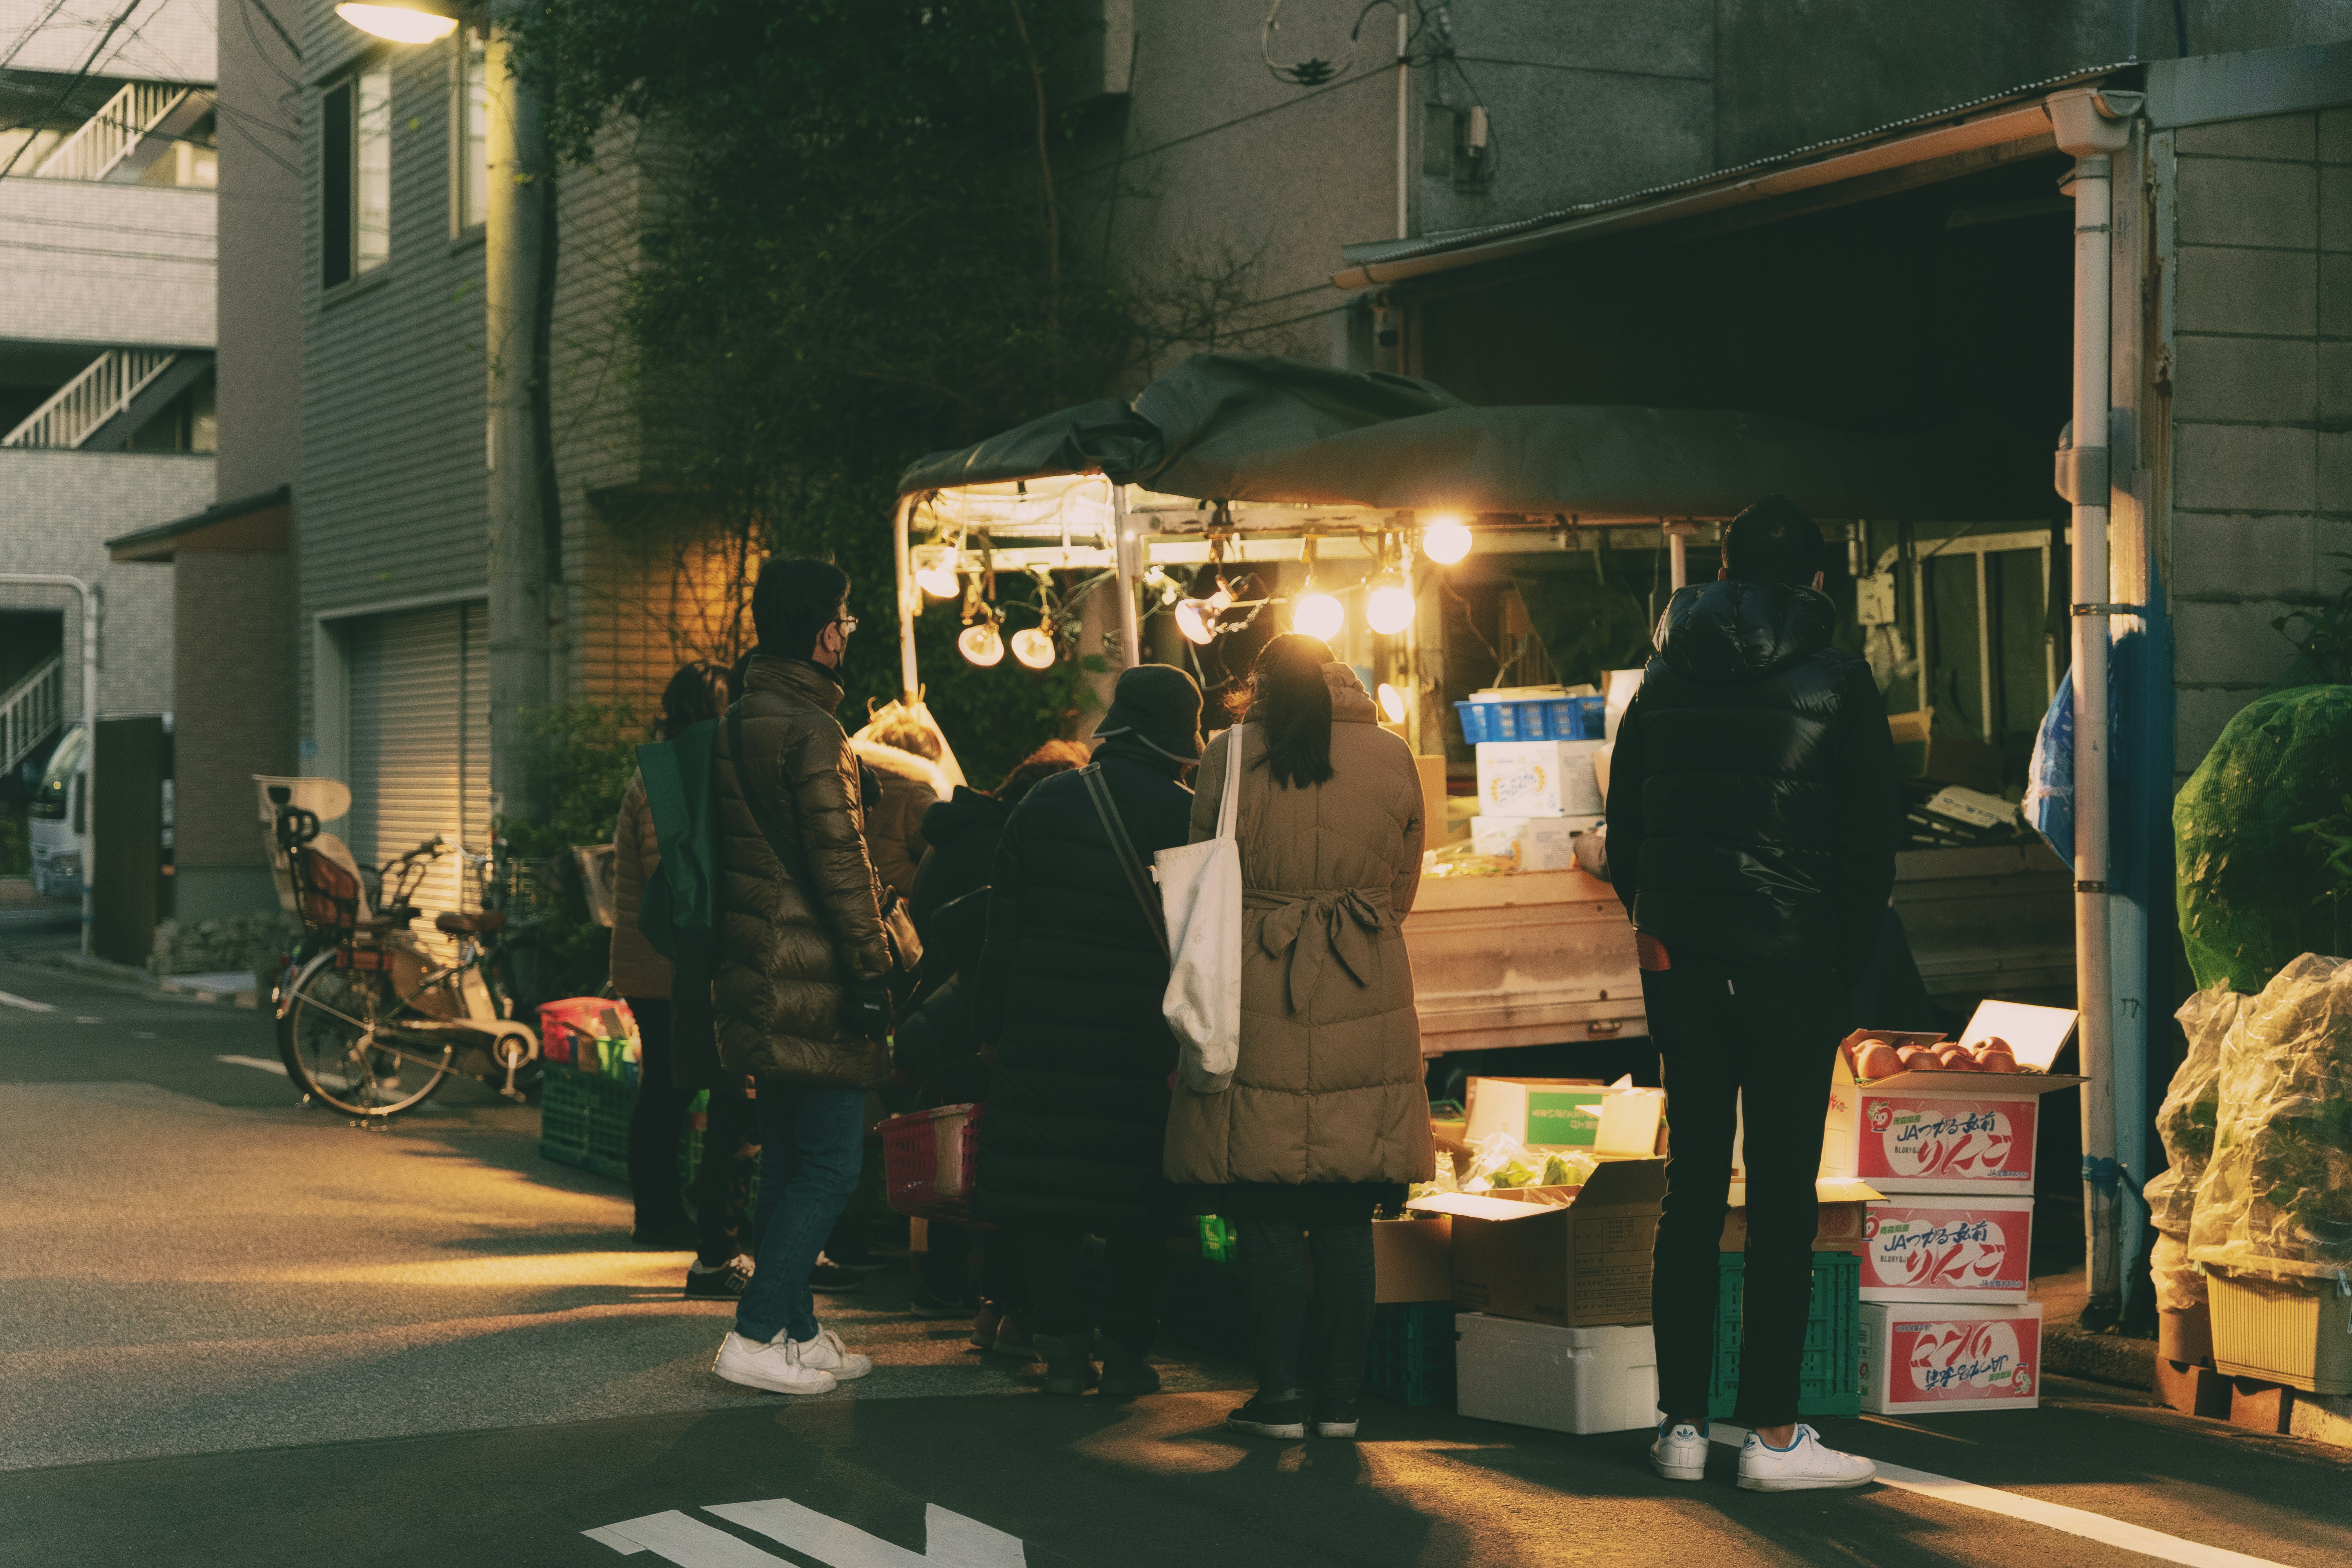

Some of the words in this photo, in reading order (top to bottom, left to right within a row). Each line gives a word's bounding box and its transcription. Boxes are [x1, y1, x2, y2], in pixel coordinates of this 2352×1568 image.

[1893, 1114, 1921, 1125] 青森県産
[1918, 1134, 2013, 1175] りんご
[1880, 1224, 1910, 1235] 青森県産
[1907, 1243, 2007, 1283] りんご
[1910, 1325, 1991, 1368] りんご
